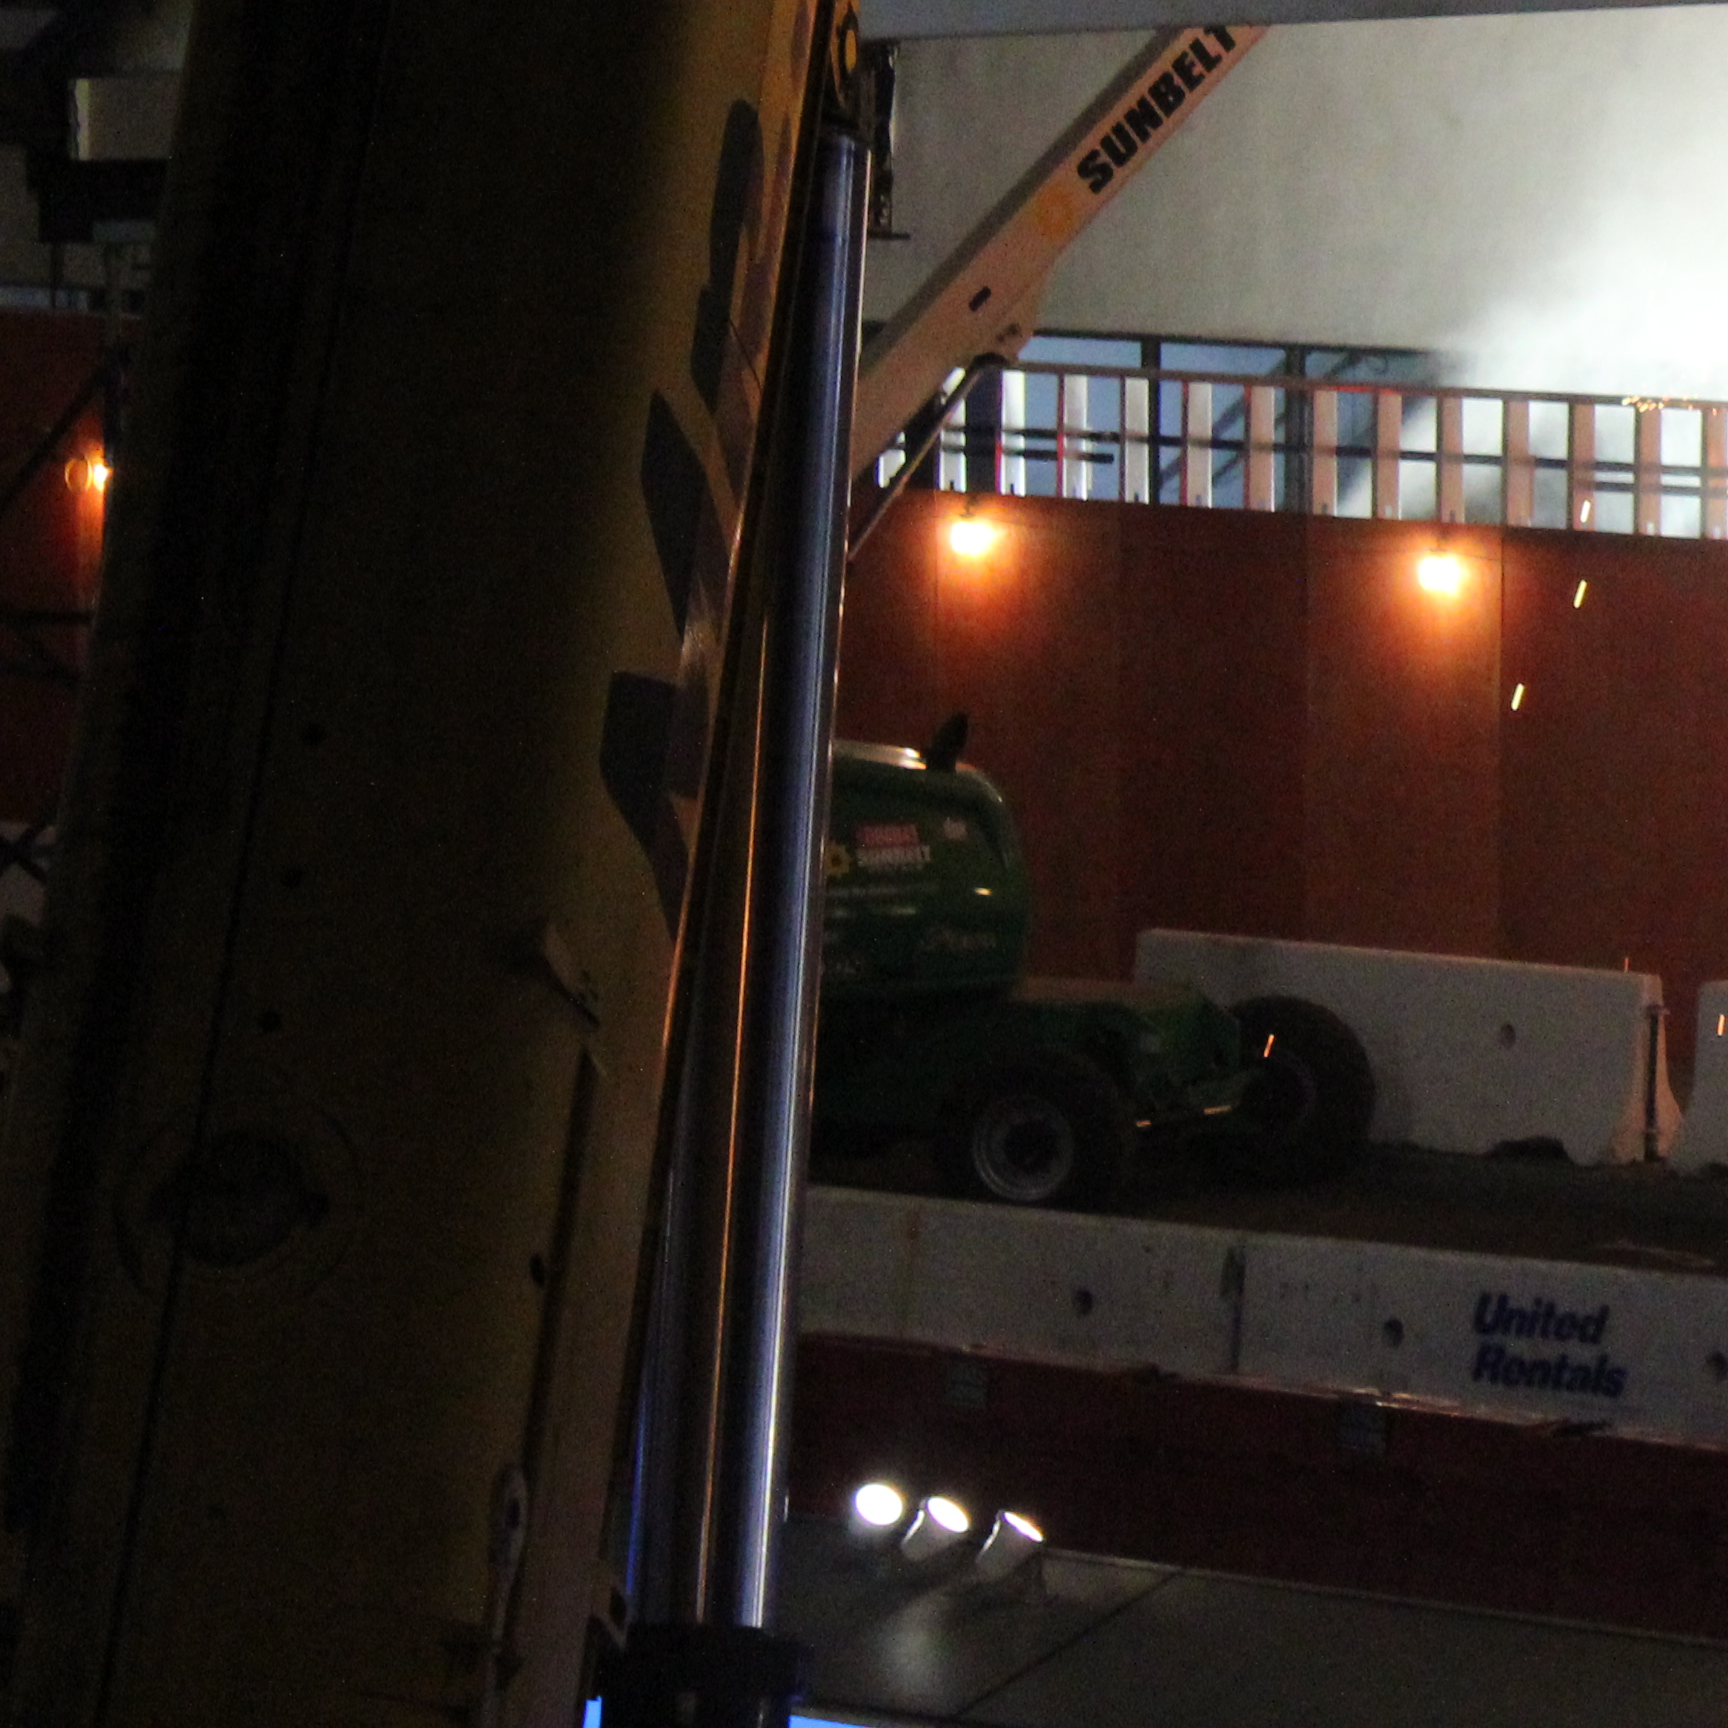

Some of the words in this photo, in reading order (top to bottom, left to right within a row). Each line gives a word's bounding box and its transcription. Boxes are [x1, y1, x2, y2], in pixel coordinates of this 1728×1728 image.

[1077, 25, 1236, 194] SUNBELT
[1475, 1292, 1610, 1344] United
[1473, 1344, 1628, 1398] Rentals
